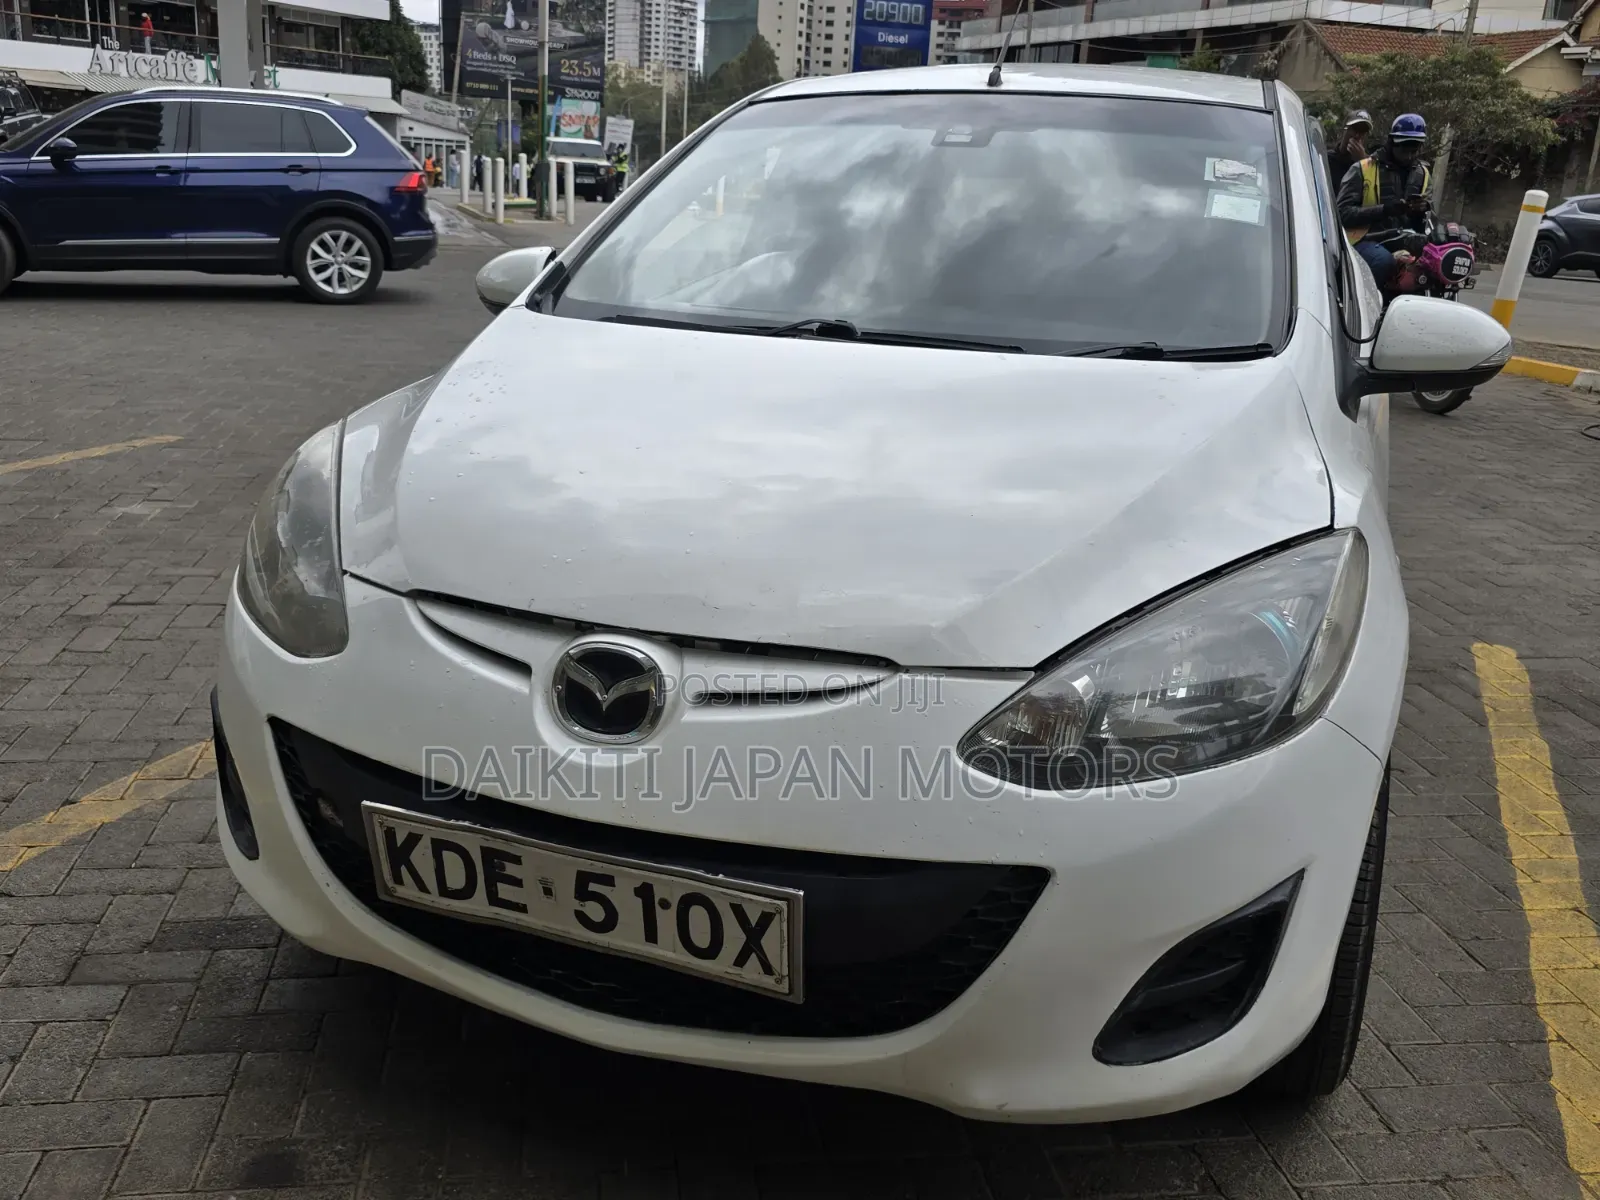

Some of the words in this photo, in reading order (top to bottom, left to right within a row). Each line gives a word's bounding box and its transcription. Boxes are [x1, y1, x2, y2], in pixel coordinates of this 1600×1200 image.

[102, 36, 120, 50] The
[877, 31, 909, 44] Diesel
[465, 48, 473, 59] 4
[473, 50, 492, 61] Beds
[499, 53, 517, 65] DSQ
[561, 58, 592, 77] 23.5
[383, 826, 529, 915] KDE
[572, 868, 778, 977] 510X
